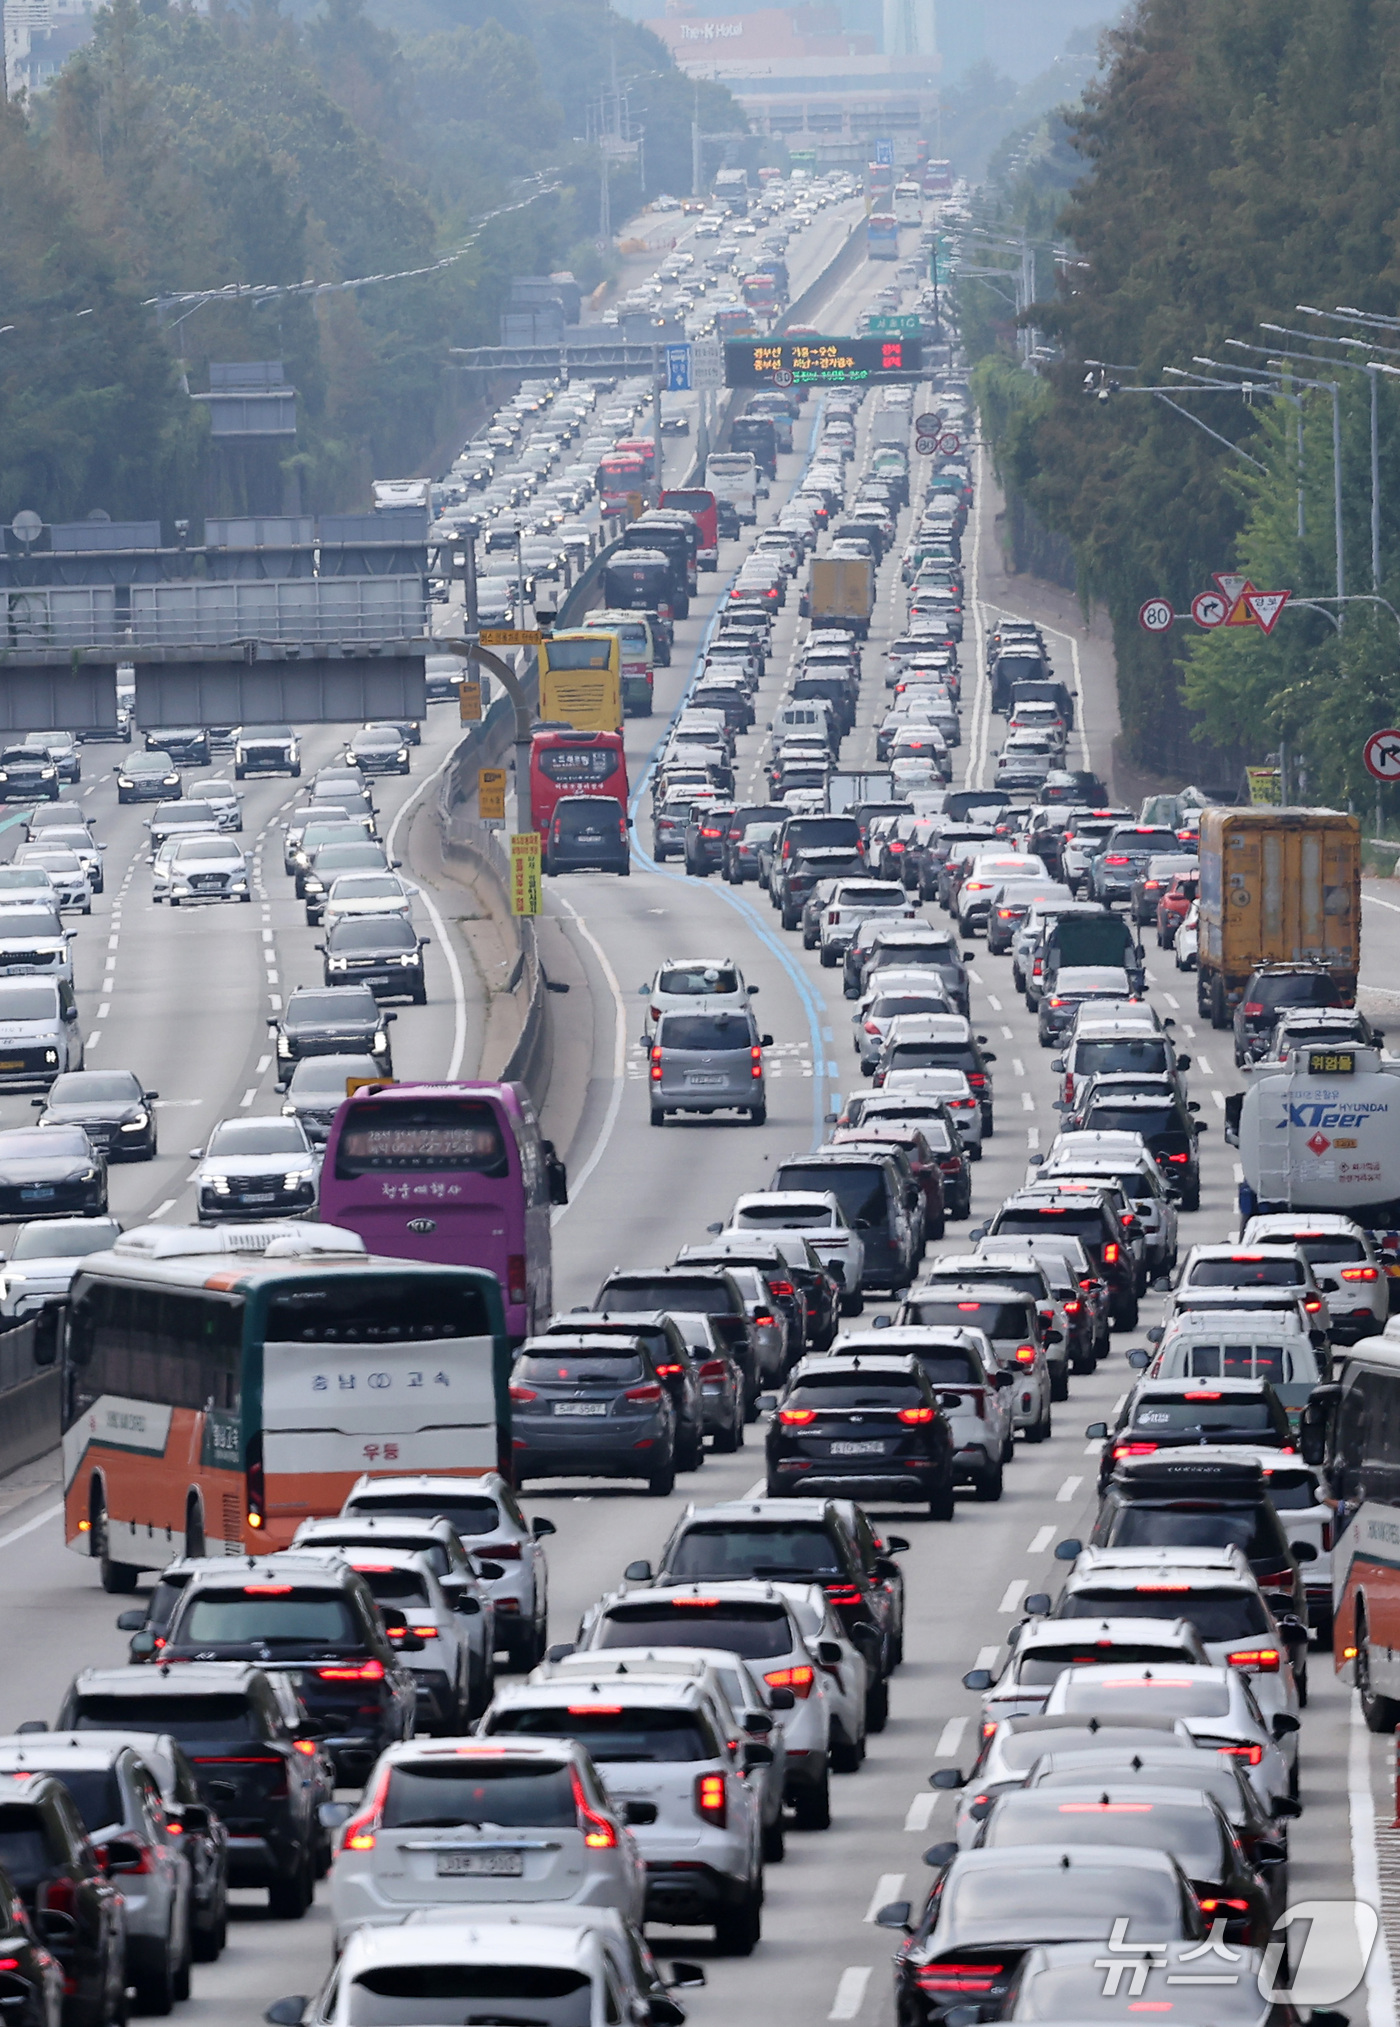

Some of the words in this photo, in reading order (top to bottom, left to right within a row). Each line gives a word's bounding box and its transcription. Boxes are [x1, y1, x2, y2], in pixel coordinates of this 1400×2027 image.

[716, 21, 743, 38] Hotel
[753, 346, 782, 358] 경부선
[1147, 608, 1168, 625] 80
[1311, 1056, 1352, 1071] 위험물
[1314, 1090, 1340, 1101] 윤활유
[1276, 1103, 1370, 1128] XTeer
[1339, 1103, 1388, 1113] HYUNDAI
[382, 1182, 463, 1199] 청운여행사
[363, 1443, 399, 1460] 우등
